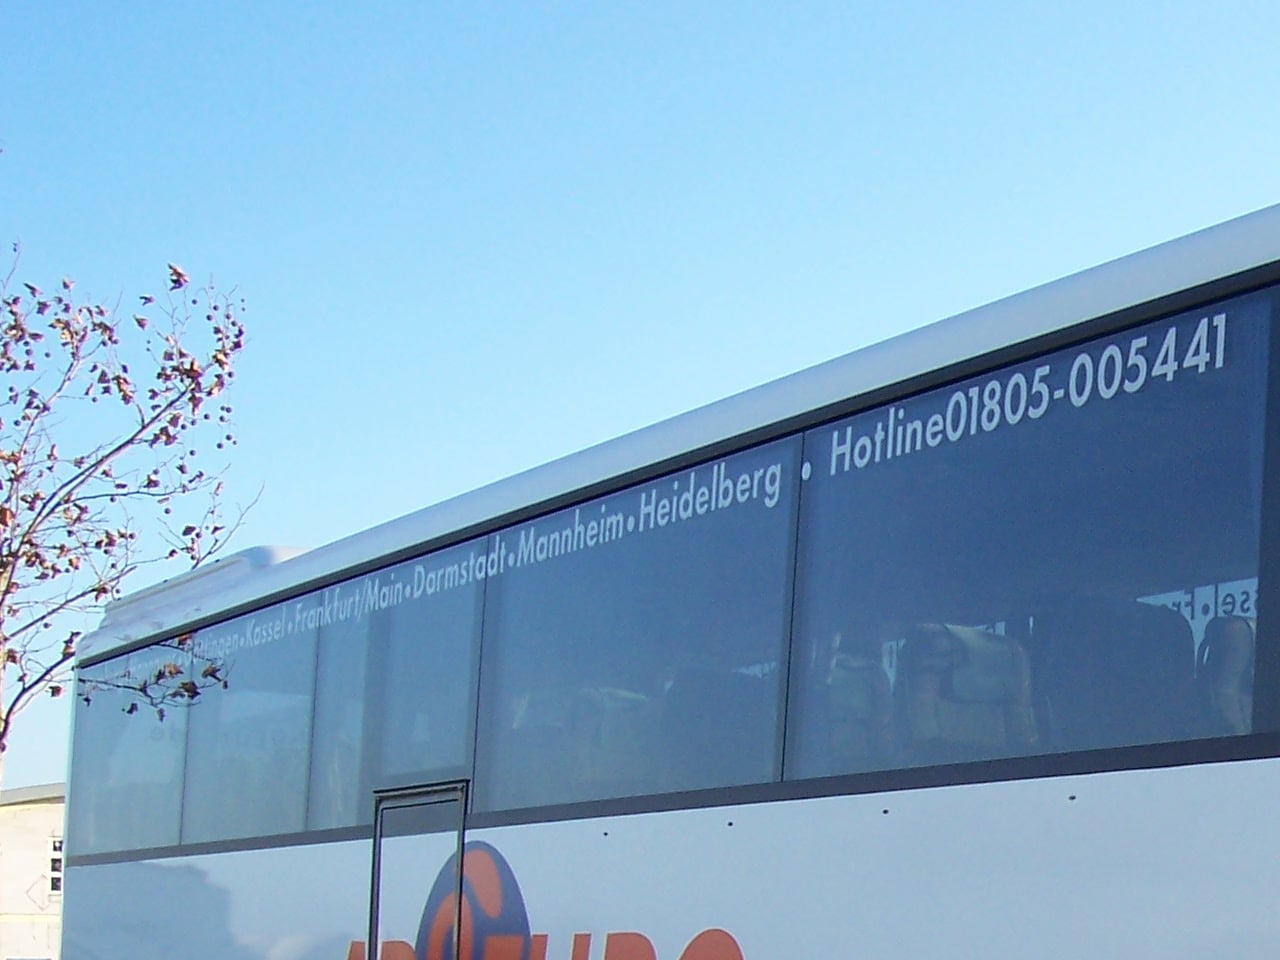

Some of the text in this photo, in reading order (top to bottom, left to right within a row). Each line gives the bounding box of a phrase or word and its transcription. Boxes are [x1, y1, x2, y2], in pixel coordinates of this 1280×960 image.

[245, 613, 286, 649] Kassel
[413, 535, 506, 599] Darmstadt
[516, 504, 623, 567] Mannheim
[638, 461, 782, 532] Heidelberg
